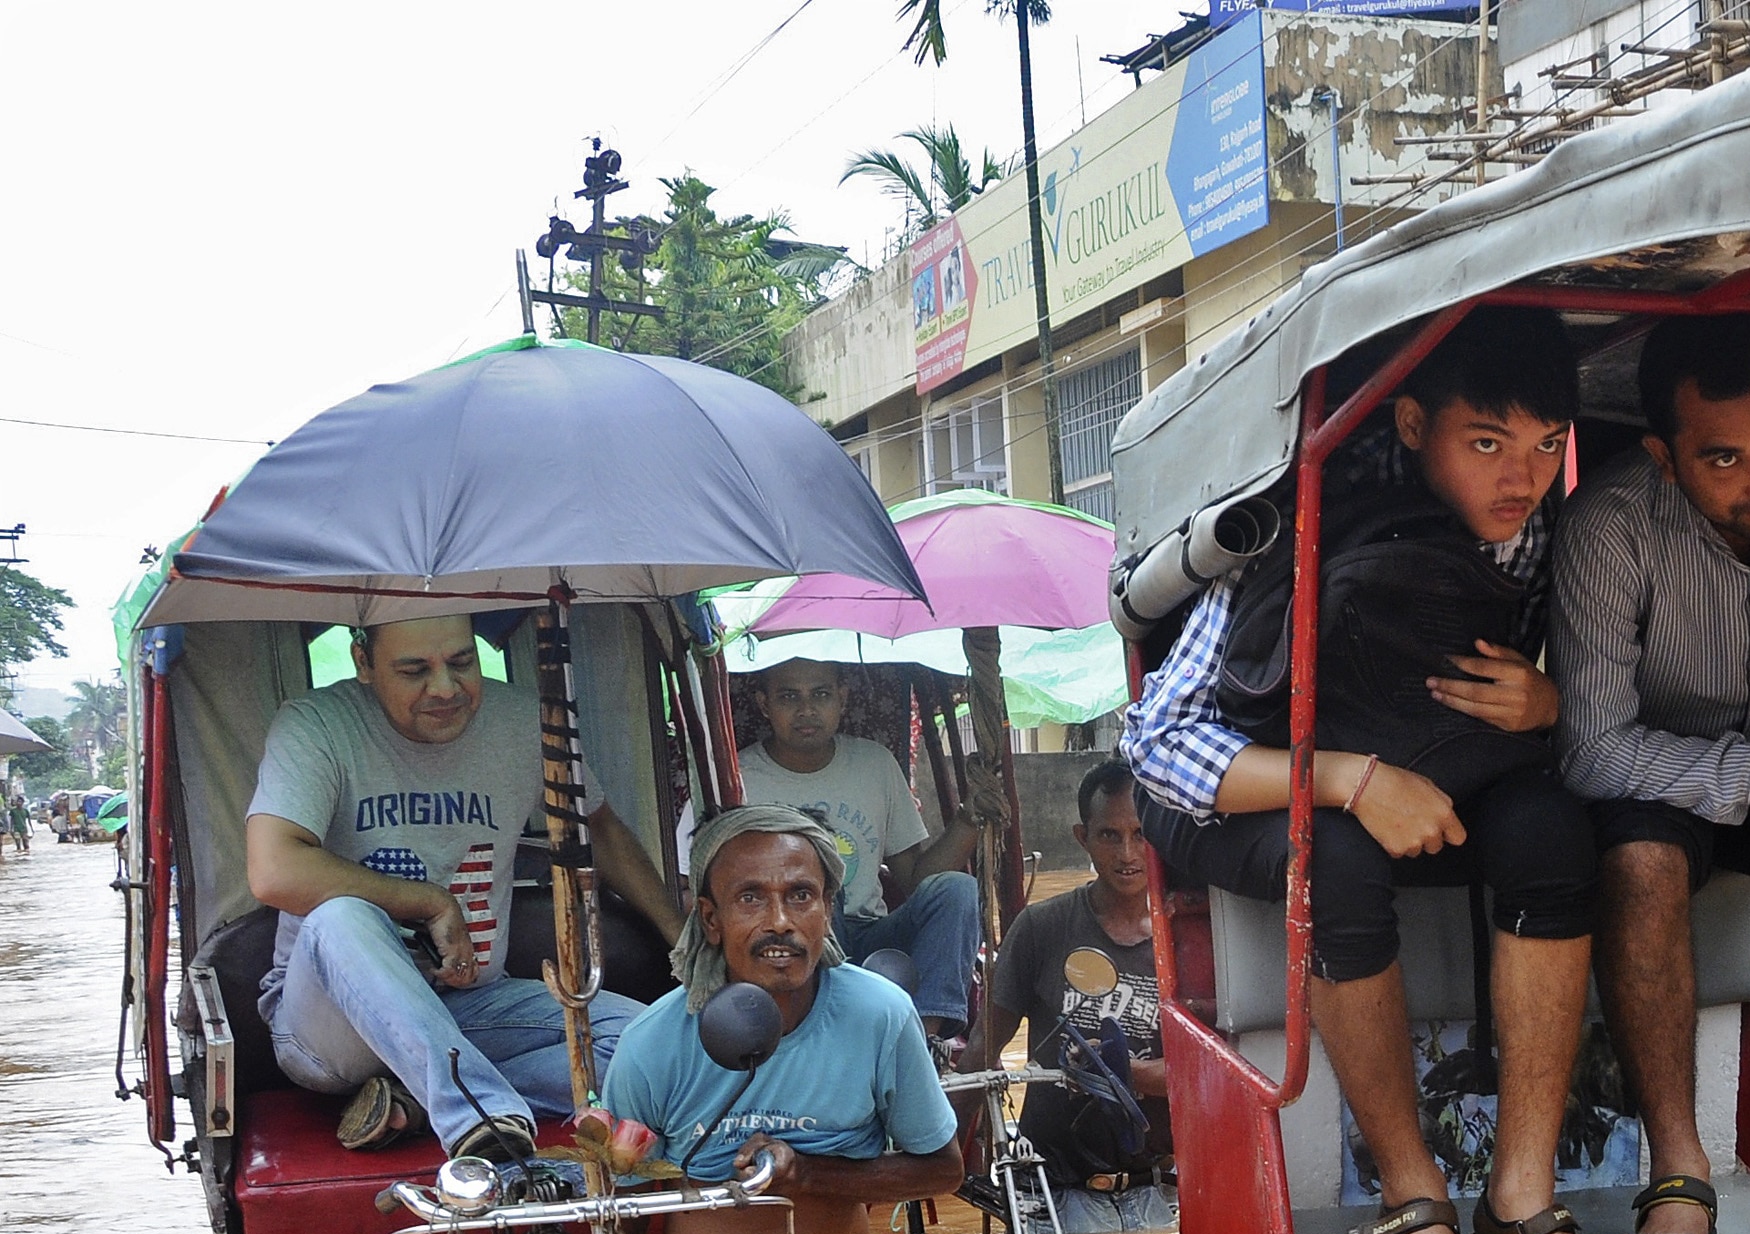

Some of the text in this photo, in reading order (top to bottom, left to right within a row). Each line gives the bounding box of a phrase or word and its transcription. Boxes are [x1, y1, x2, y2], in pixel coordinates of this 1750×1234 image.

[1220, 0, 1273, 11] FLYEAY
[1066, 162, 1166, 265] GURUKUL
[982, 238, 1035, 309] TRAVE
[355, 791, 500, 832] ORIGINAL
